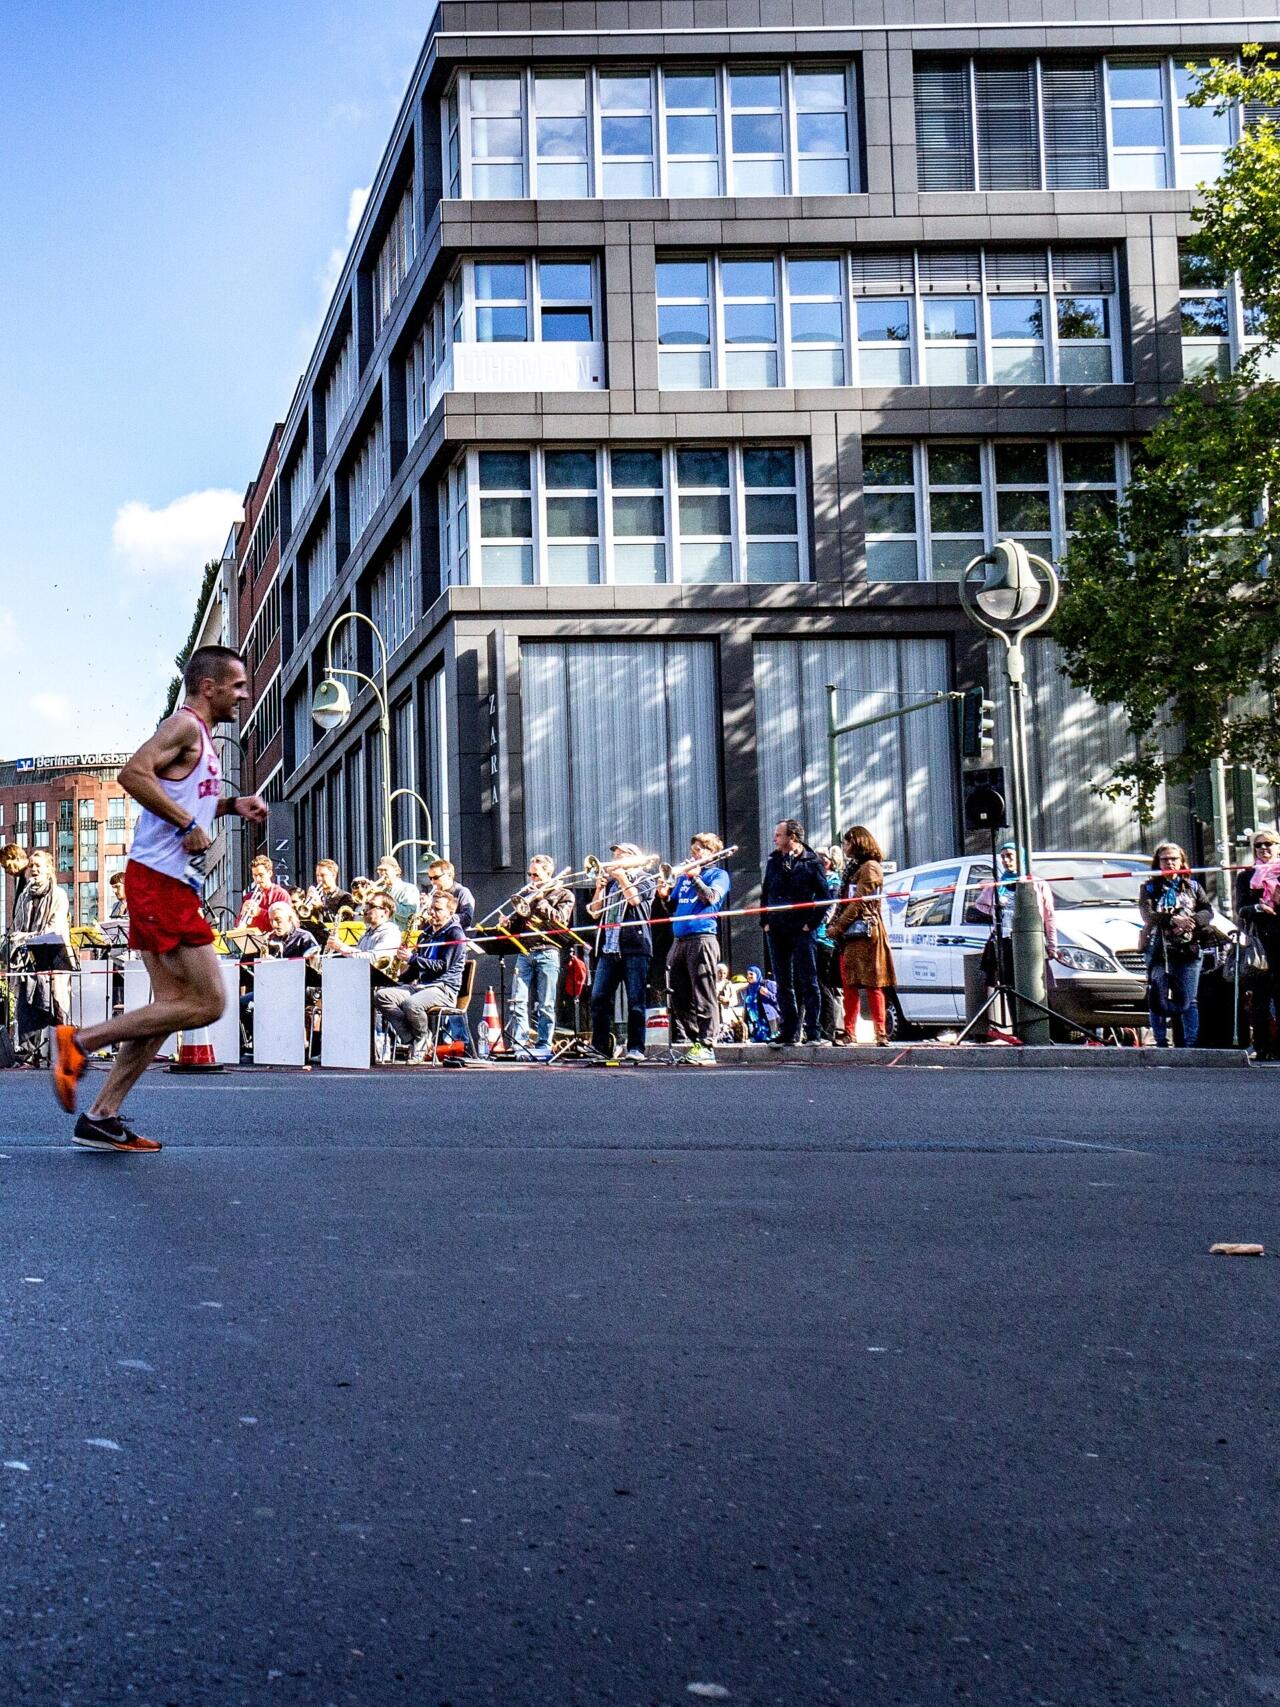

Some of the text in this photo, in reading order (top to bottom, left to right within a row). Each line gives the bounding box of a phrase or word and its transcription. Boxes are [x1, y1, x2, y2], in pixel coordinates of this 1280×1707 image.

[36, 753, 134, 768] Berliner Volksban
[488, 693, 499, 806] ZARA
[275, 839, 290, 886] ZAR
